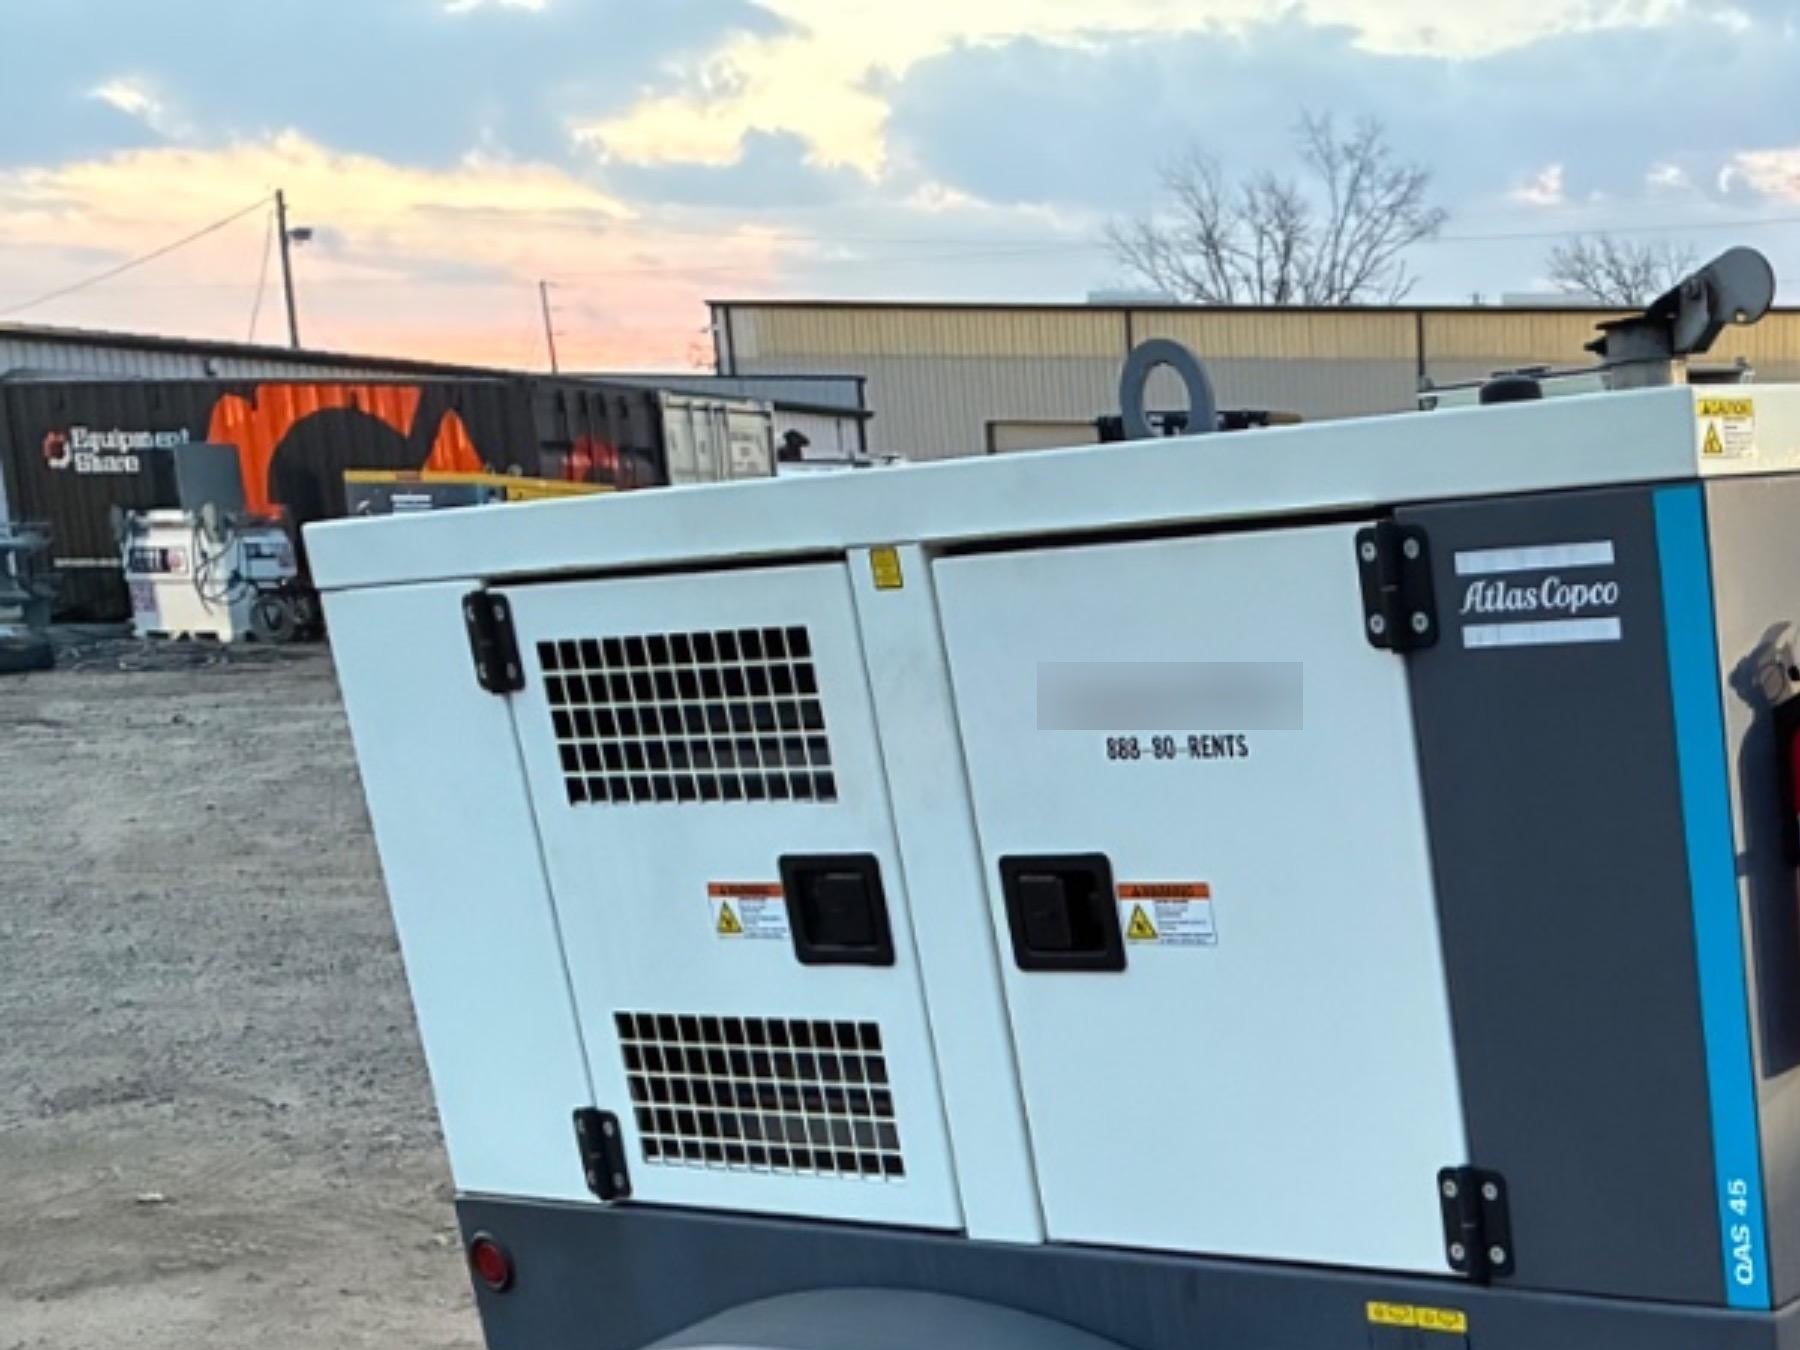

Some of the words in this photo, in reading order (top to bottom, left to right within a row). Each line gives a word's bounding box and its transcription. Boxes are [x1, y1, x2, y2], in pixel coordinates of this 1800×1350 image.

[73, 452, 140, 474] Share
[1459, 579, 1538, 616] Atlas
[1539, 575, 1619, 615] Copco
[1727, 1178, 1748, 1216] 45
[1730, 1223, 1754, 1286] QAS
